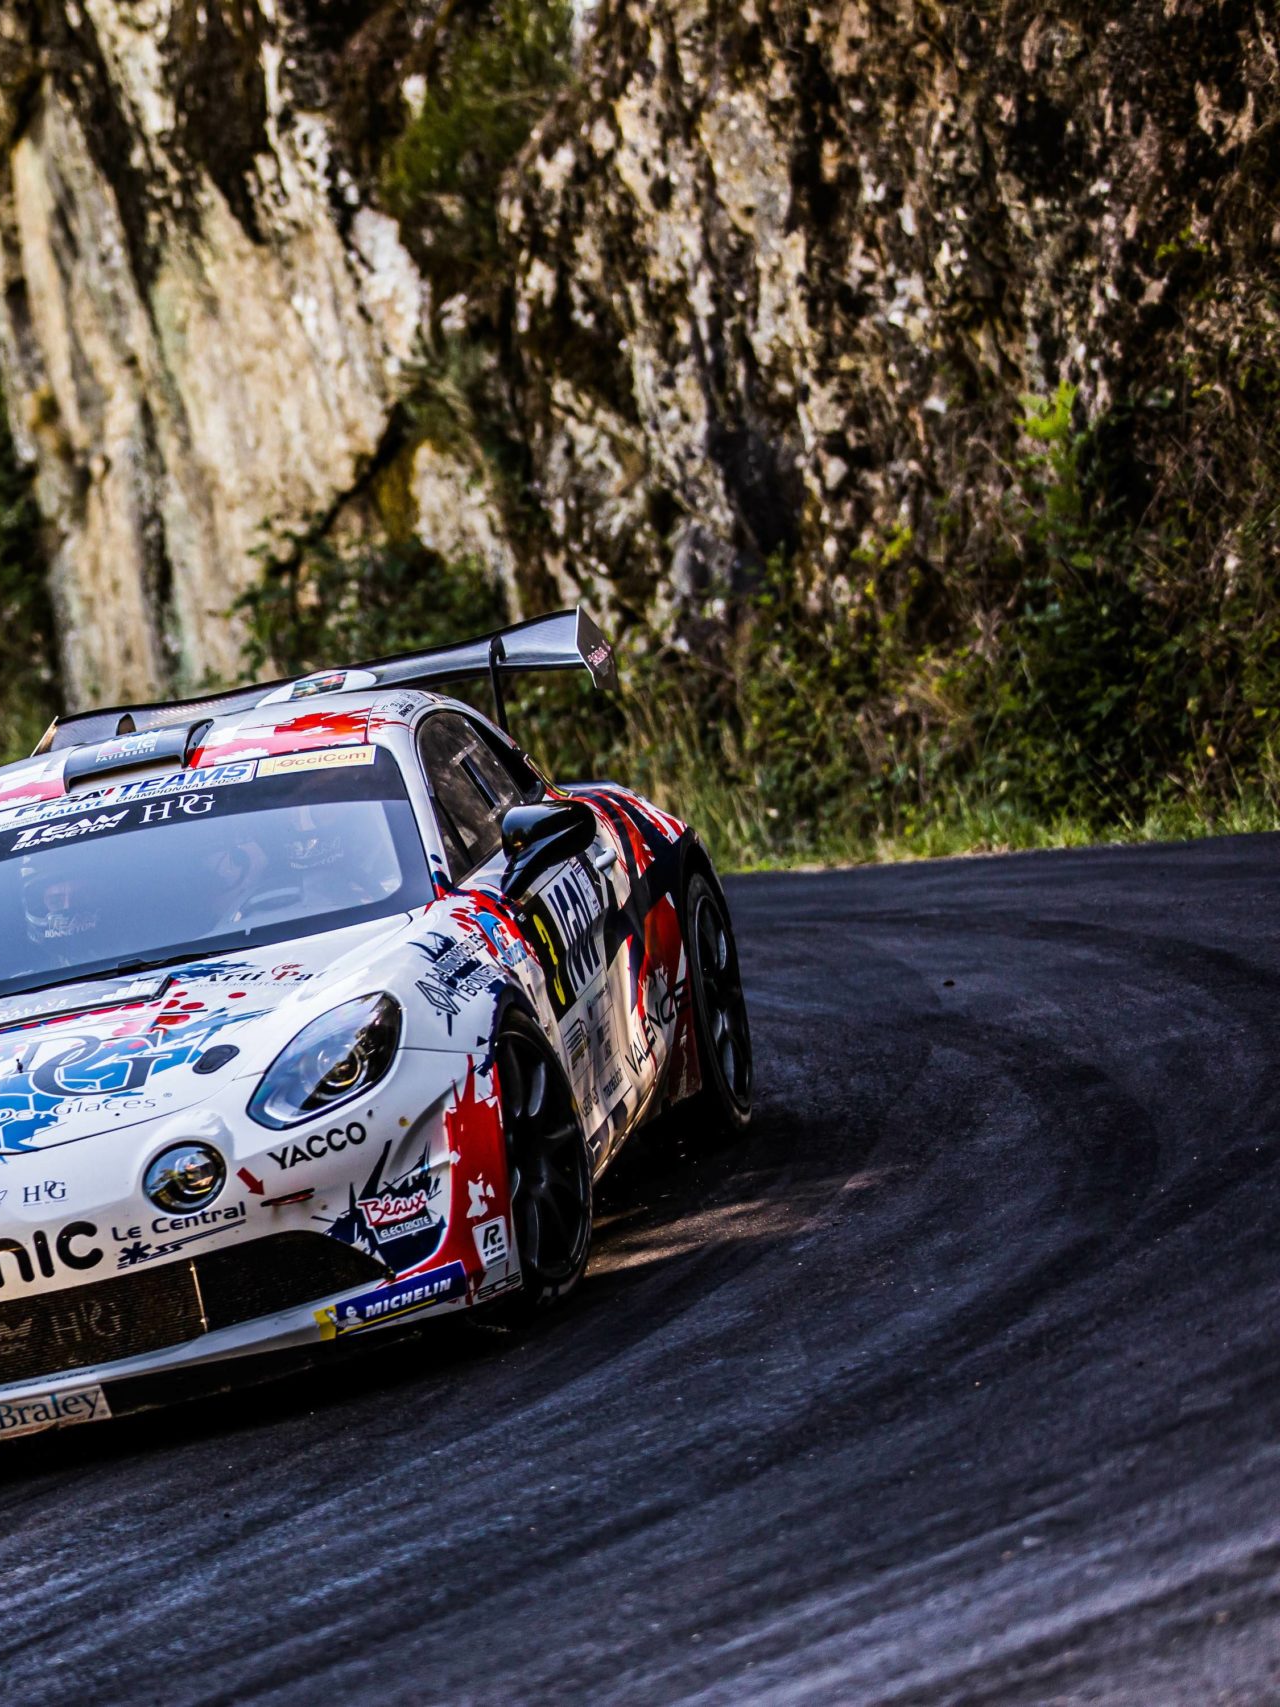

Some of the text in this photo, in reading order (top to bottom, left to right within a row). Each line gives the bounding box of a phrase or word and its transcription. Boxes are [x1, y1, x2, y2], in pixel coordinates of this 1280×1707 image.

[120, 763, 250, 797] TEAMS
[39, 800, 104, 819] RALLYE
[116, 782, 206, 803] CHAMPIONNAT
[10, 821, 120, 851] BONNETON
[16, 809, 130, 843] TEAM
[625, 978, 689, 1077] VALENCE
[53, 1098, 157, 1115] Glaces
[266, 1121, 367, 1170] YACCO
[151, 1200, 246, 1234] Central
[365, 1277, 452, 1318] MICHELIN
